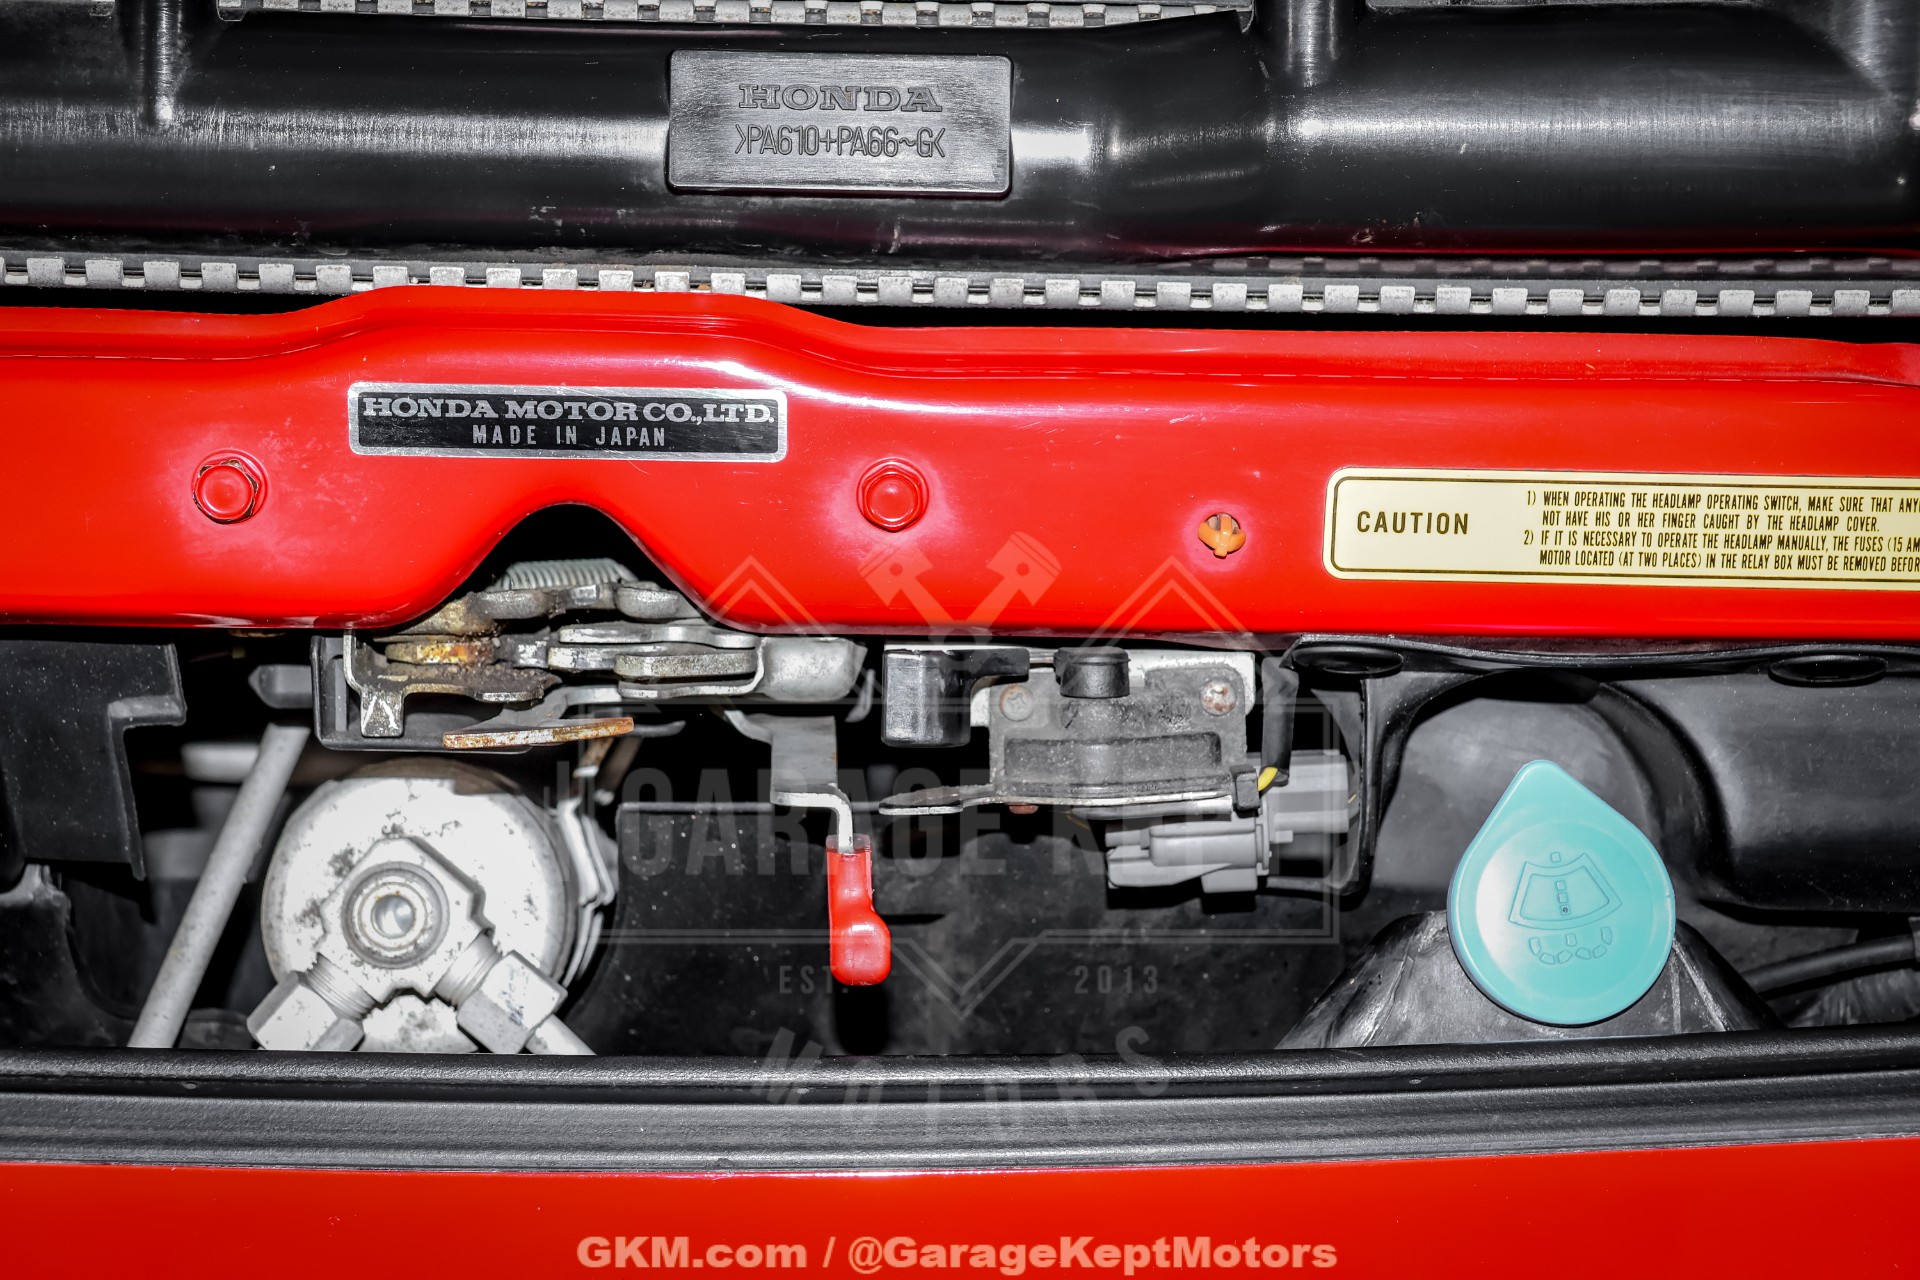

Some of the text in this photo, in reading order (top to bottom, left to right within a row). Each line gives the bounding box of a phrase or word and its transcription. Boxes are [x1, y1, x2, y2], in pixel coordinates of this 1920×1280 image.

[738, 83, 943, 113] HONDA
[363, 397, 499, 419] HONDA
[504, 400, 639, 422] MOTOR
[472, 425, 667, 447] MADE IN JAPAN
[1527, 490, 1920, 513] 1) WHEN OPERATING THE HEADLAMP OPERATING SWITCH, MAKE SURE THAT ANY
[1356, 510, 1470, 535] CAUTION
[1542, 510, 1880, 532] NOT HAVE HIS OR HER FINGER CAUGHT BY THE HEADLAMP COVER.
[1523, 529, 1534, 545] 2)
[1541, 530, 1550, 546] IF
[1554, 530, 1563, 546] IT
[1568, 530, 1578, 546] IS
[1582, 531, 1637, 547] NECESSARY
[1641, 532, 1652, 547] TO
[1657, 532, 1699, 549] OPERATE
[1703, 533, 1719, 549] THE
[1723, 534, 1773, 550] HEADLAMP
[1777, 535, 1829, 553] MANUALLY,
[1833, 535, 1849, 551] THE
[1854, 536, 1884, 552] FUSES
[1887, 536, 1903, 553] (15
[1539, 549, 1571, 566] MOTOR
[1575, 550, 1614, 566] LOCATED
[1618, 551, 1634, 567] (AT
[1638, 552, 1658, 568] TWO
[1662, 552, 1702, 568] PLACES)
[1706, 553, 1716, 569] IN
[1721, 553, 1737, 569] THE
[1741, 554, 1770, 570] RELAY
[1774, 554, 1793, 570] BOX
[1797, 555, 1823, 571] MUST
[1827, 555, 1839, 571] BE
[1843, 556, 1886, 572] REMOVED
